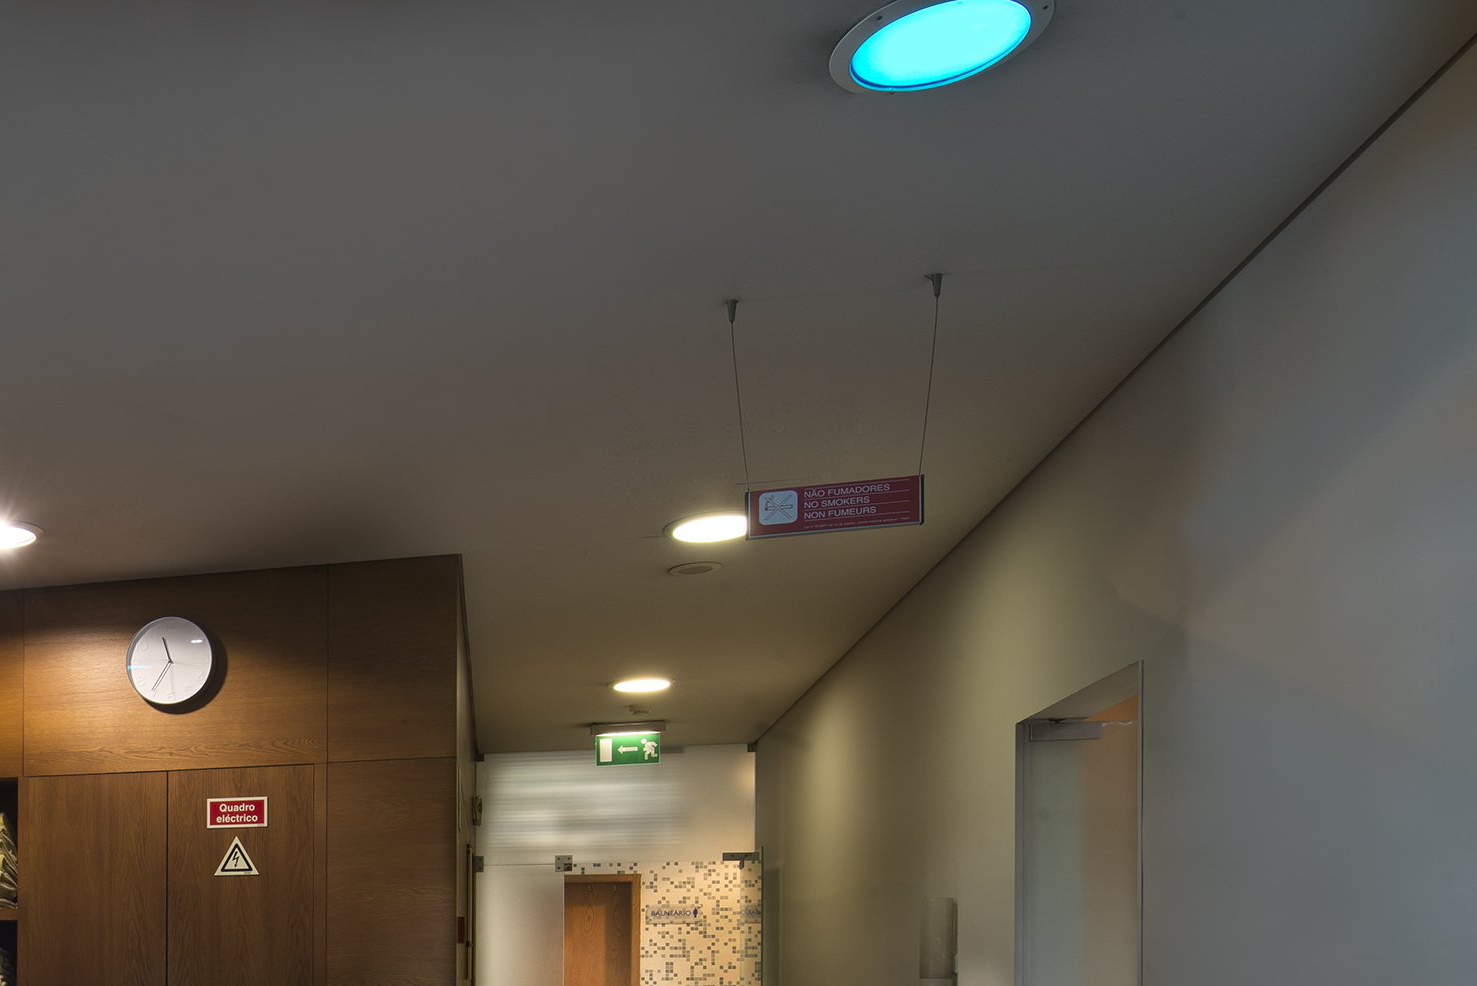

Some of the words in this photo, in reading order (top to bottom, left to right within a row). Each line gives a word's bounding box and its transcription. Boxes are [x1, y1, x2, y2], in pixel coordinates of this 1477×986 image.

[803, 489, 826, 498] NÃO
[827, 483, 891, 496] FUMADORES
[803, 500, 819, 509] NO
[821, 496, 870, 507] SMOKERS
[803, 511, 826, 520] NON
[828, 506, 877, 517] FUMEURS
[219, 803, 255, 812] Quadro
[216, 814, 259, 823] eléctrico
